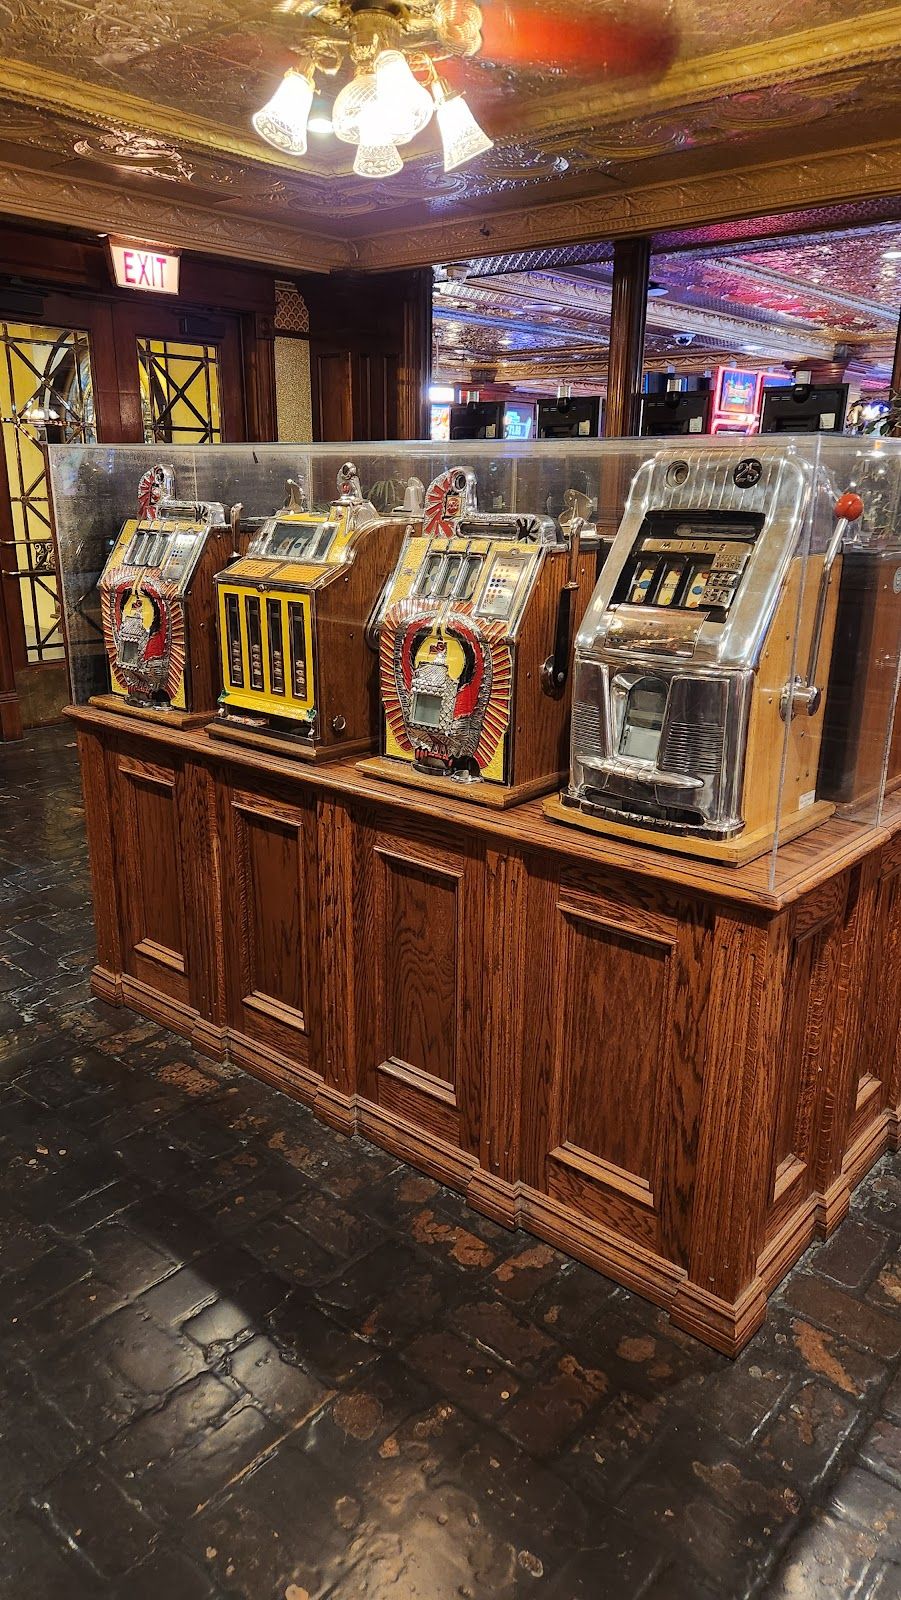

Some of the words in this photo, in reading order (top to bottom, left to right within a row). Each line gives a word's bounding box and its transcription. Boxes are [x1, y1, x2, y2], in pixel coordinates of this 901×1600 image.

[123, 251, 167, 288] EXIT
[735, 462, 760, 482] 25
[660, 541, 727, 552] MILLS
[712, 561, 741, 569] AWARD
